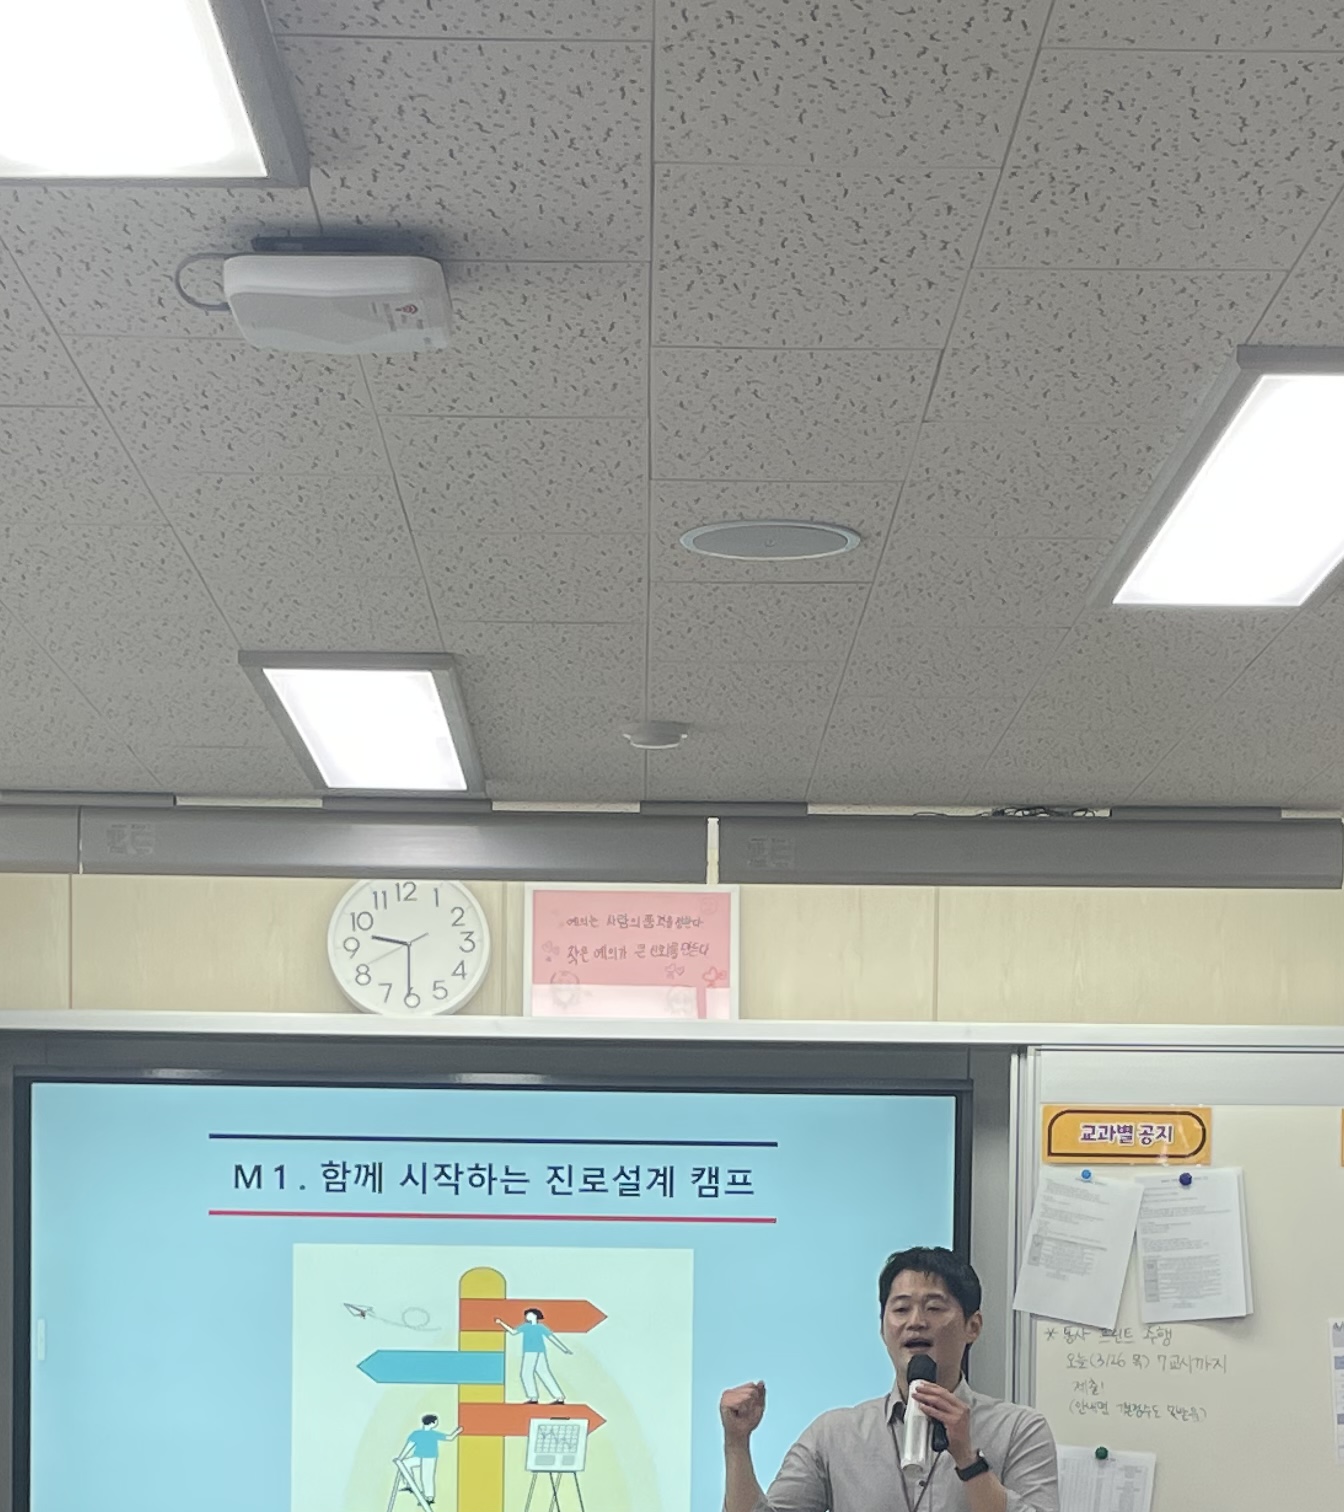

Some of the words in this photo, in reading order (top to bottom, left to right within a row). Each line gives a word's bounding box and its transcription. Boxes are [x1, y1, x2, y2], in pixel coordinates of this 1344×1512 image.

[373, 890, 388, 911] 11
[395, 881, 418, 902] 12
[434, 887, 439, 908] 1
[350, 911, 374, 932] 10
[451, 906, 465, 927] 2
[343, 937, 360, 960] 9
[459, 931, 476, 953] 3
[355, 964, 371, 986] 8
[451, 960, 467, 981] 4
[378, 983, 393, 1003] 7
[404, 987, 421, 1009] 6
[432, 980, 448, 1000] 5
[1081, 1124, 1133, 1144] 교과별
[1139, 1125, 1173, 1145] 공지
[321, 1161, 384, 1195] 함께
[400, 1163, 530, 1197] 시작하는
[546, 1165, 675, 1198] 진로설계
[691, 1166, 754, 1198] 캠프
